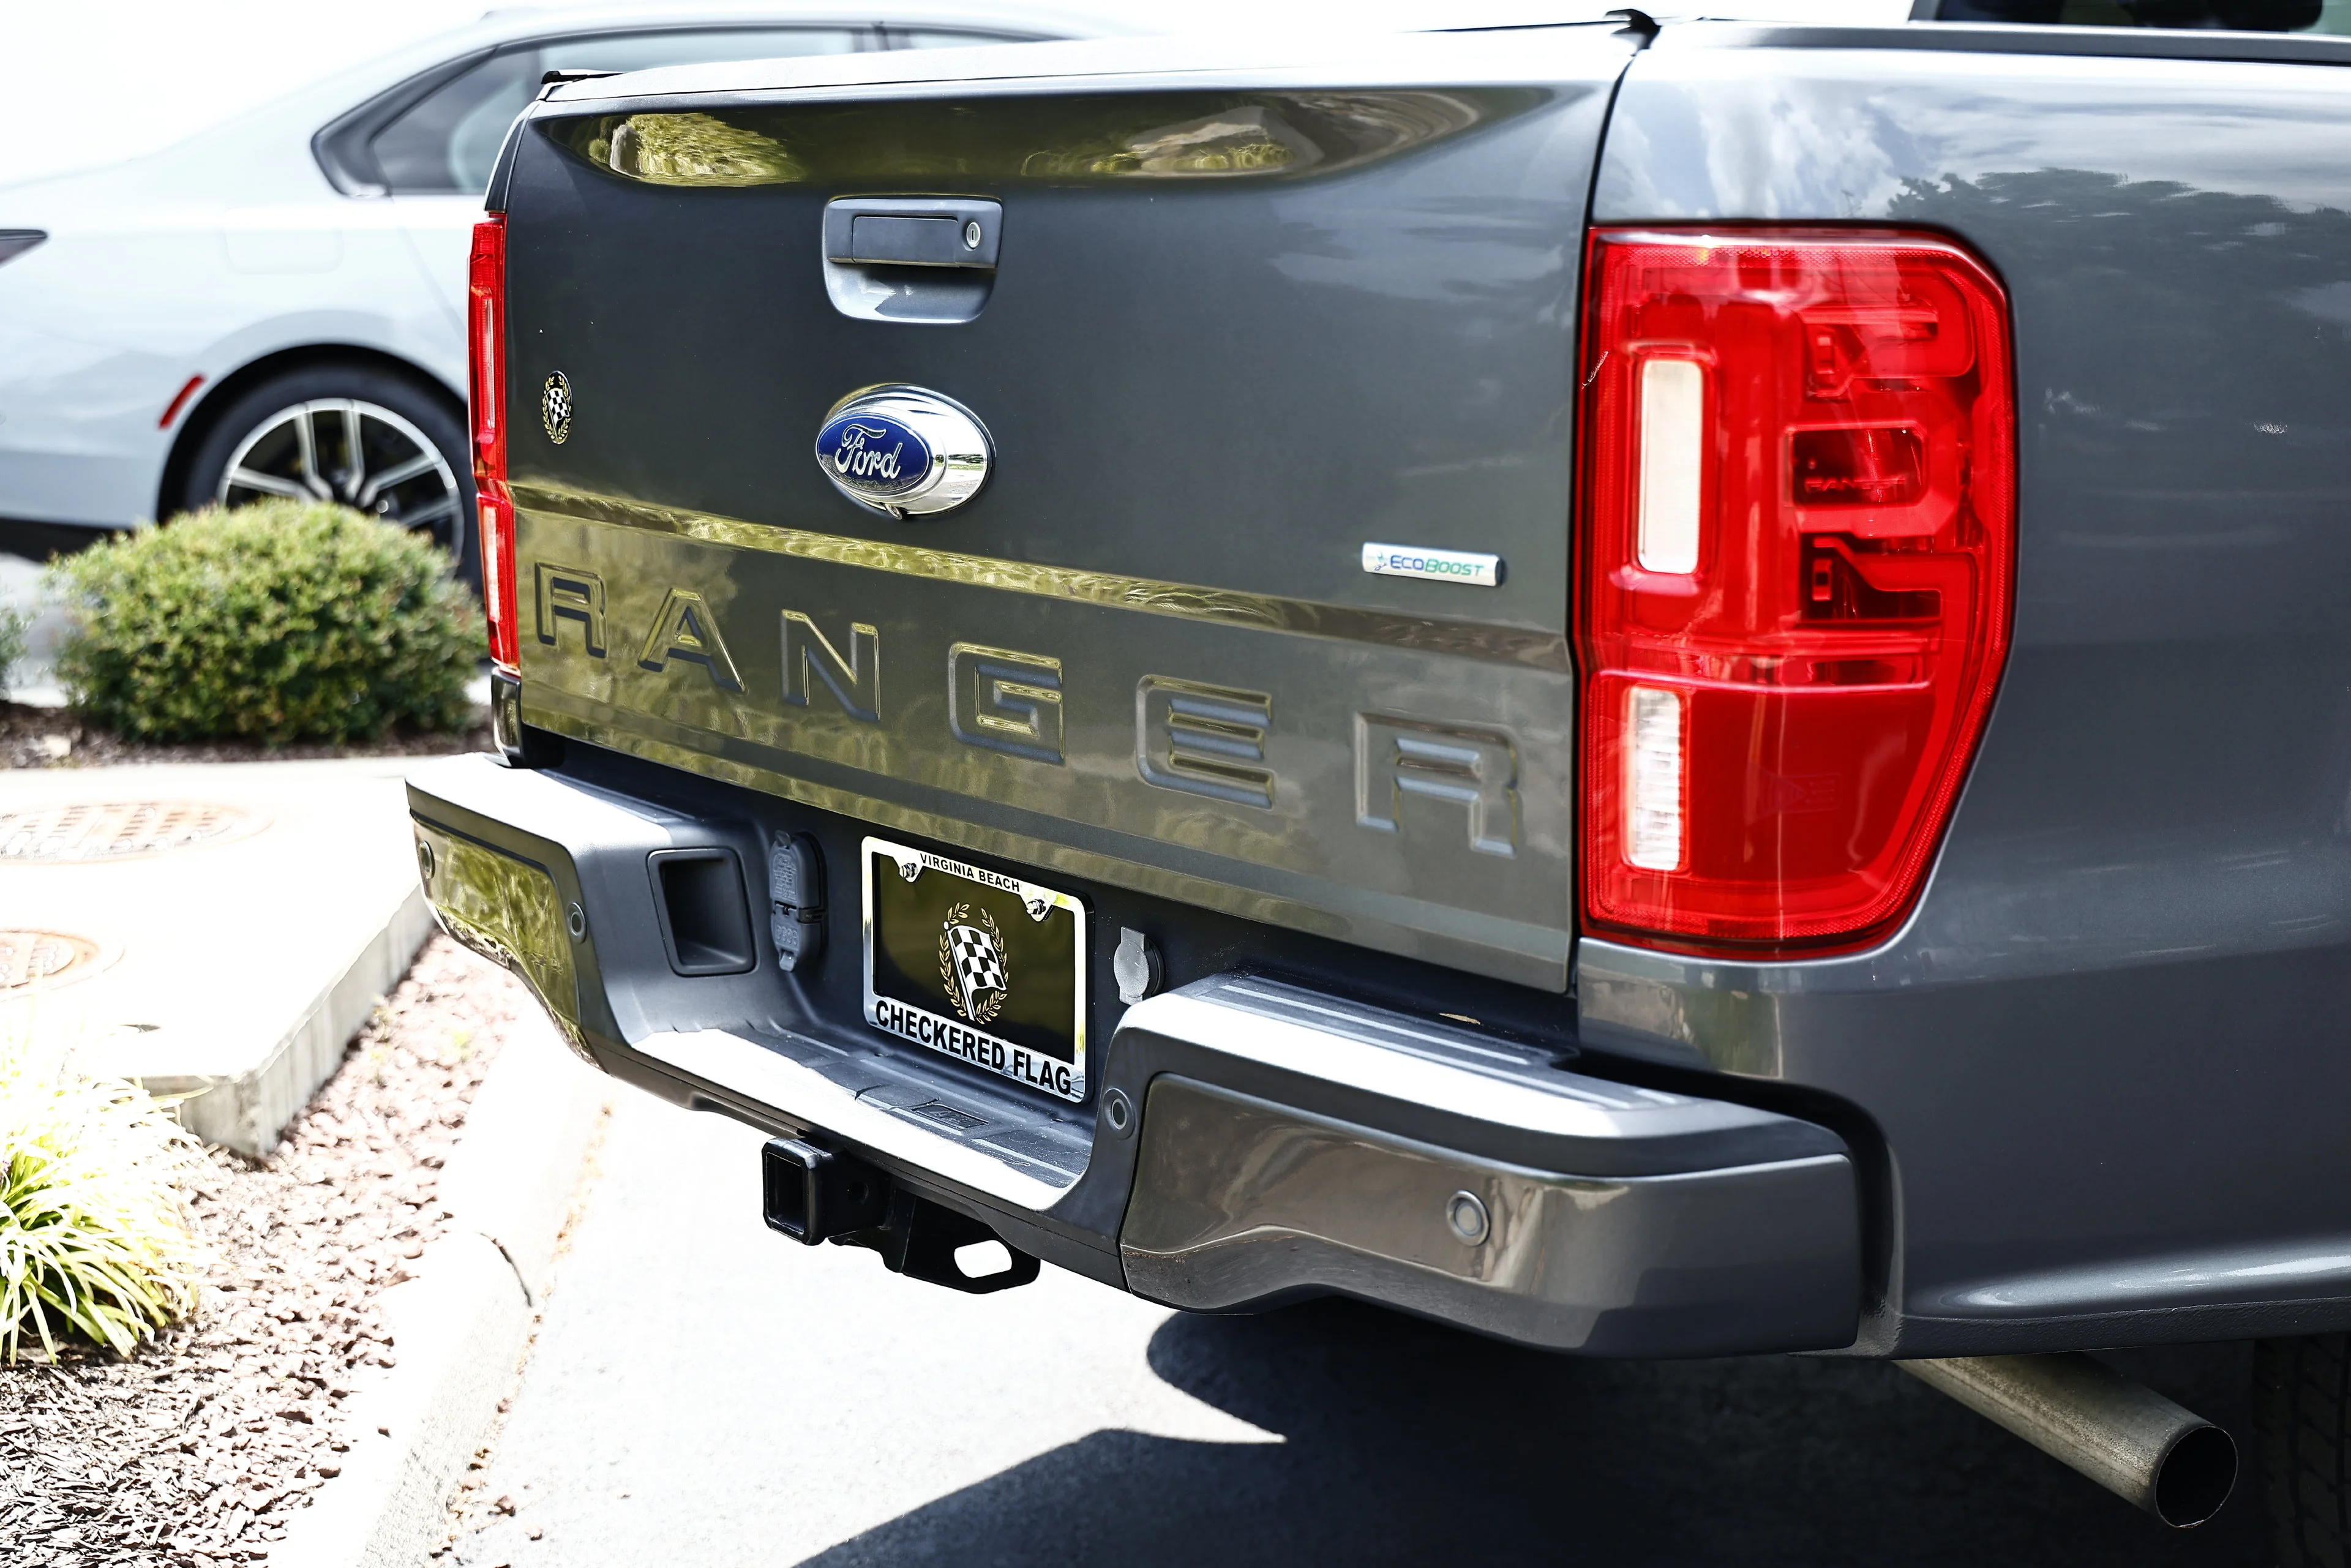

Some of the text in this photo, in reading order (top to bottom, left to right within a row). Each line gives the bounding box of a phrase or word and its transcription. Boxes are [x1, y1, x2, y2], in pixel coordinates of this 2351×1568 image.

[835, 424, 902, 479] Ford
[534, 563, 1517, 856] RANGER
[920, 853, 1020, 892] VIRGINIA BEACH
[876, 1000, 1071, 1095] CHECKERED FLAG
